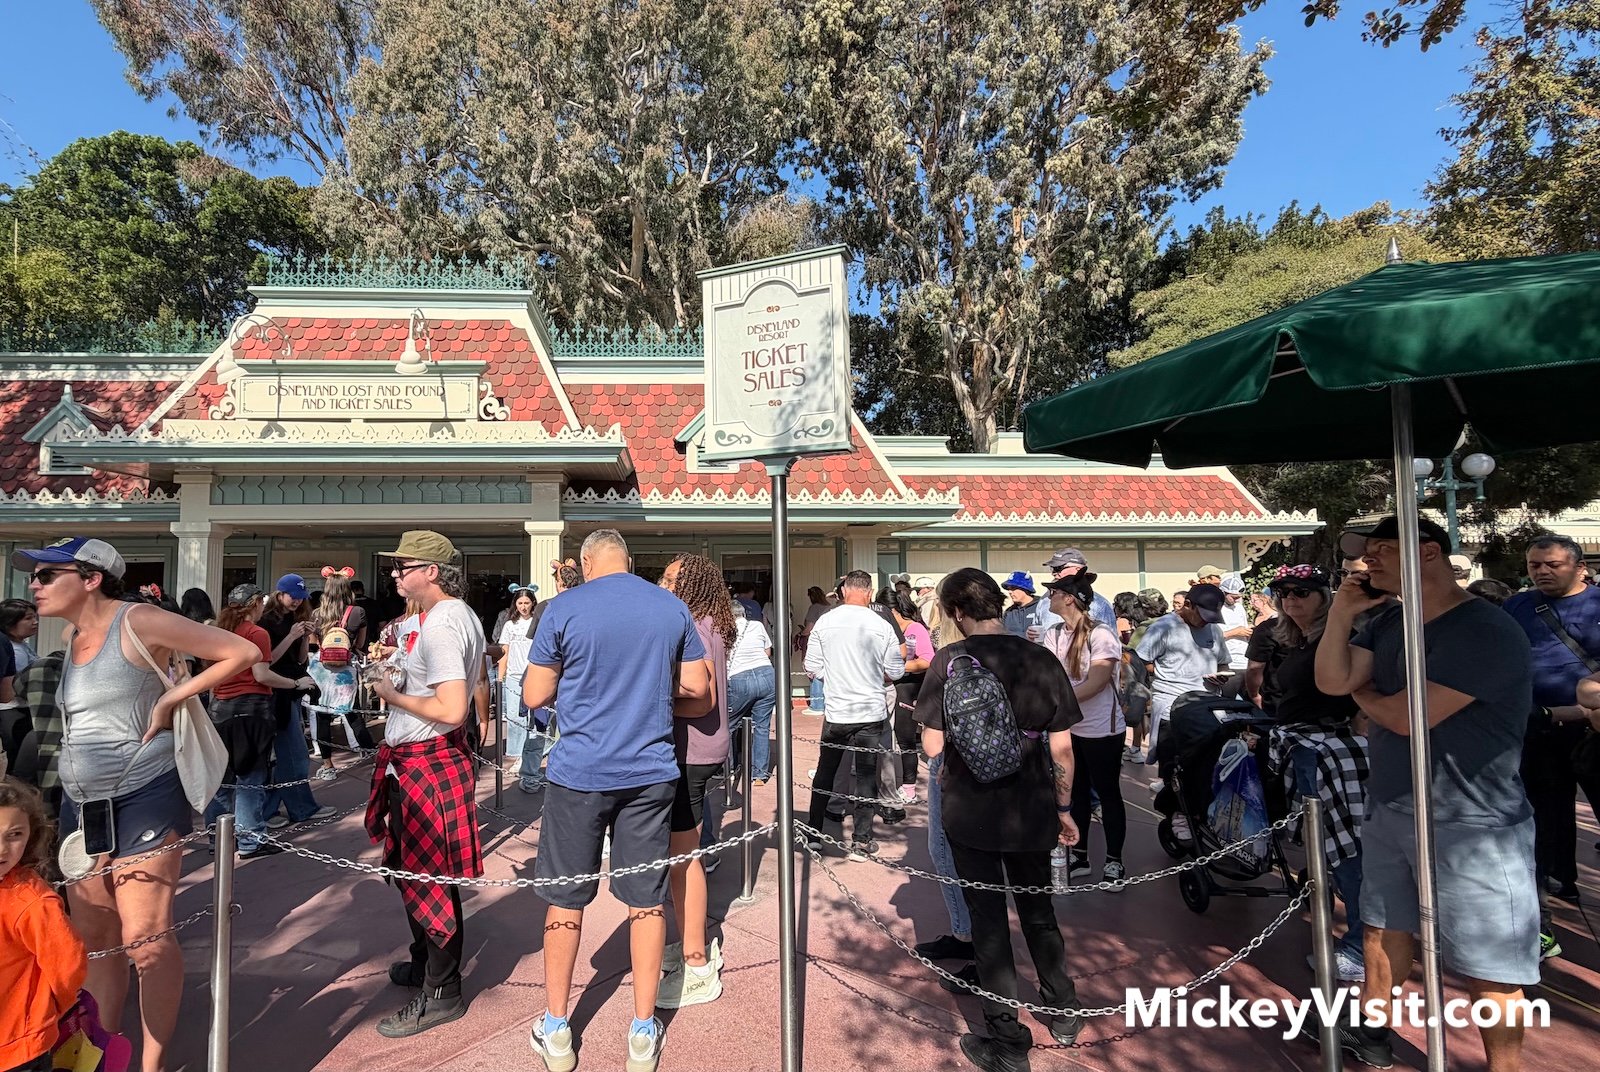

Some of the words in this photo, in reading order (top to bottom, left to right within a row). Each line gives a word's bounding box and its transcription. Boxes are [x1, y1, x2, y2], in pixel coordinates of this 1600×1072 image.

[747, 318, 800, 335] DISNEYLAND
[758, 330, 789, 342] RESORT
[741, 342, 808, 370] TICKET
[744, 367, 806, 392] SALES
[268, 384, 338, 397] DISNEYLAND
[342, 384, 373, 397] LOST
[377, 384, 401, 397] AND
[405, 384, 446, 397] FOUND
[302, 398, 326, 410] AND
[330, 397, 370, 410] TICKET
[373, 398, 413, 410] SALES
